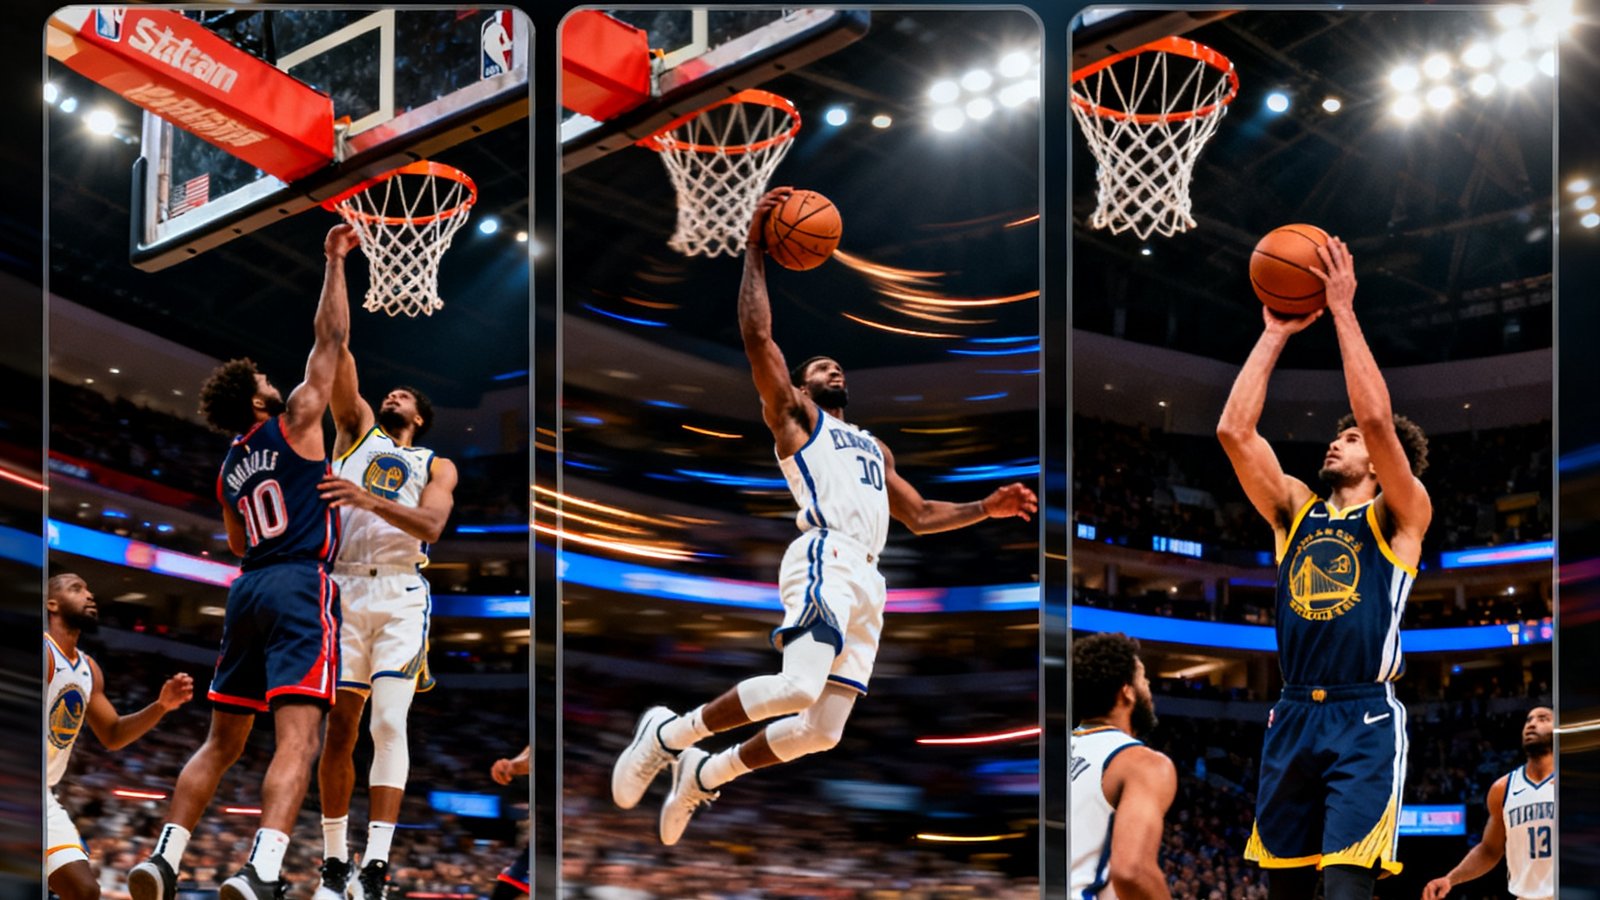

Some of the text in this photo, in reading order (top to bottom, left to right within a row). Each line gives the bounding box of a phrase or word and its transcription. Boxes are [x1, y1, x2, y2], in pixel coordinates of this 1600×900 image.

[856, 455, 883, 491] 10
[238, 478, 288, 547] 10
[1527, 826, 1552, 859] 13
